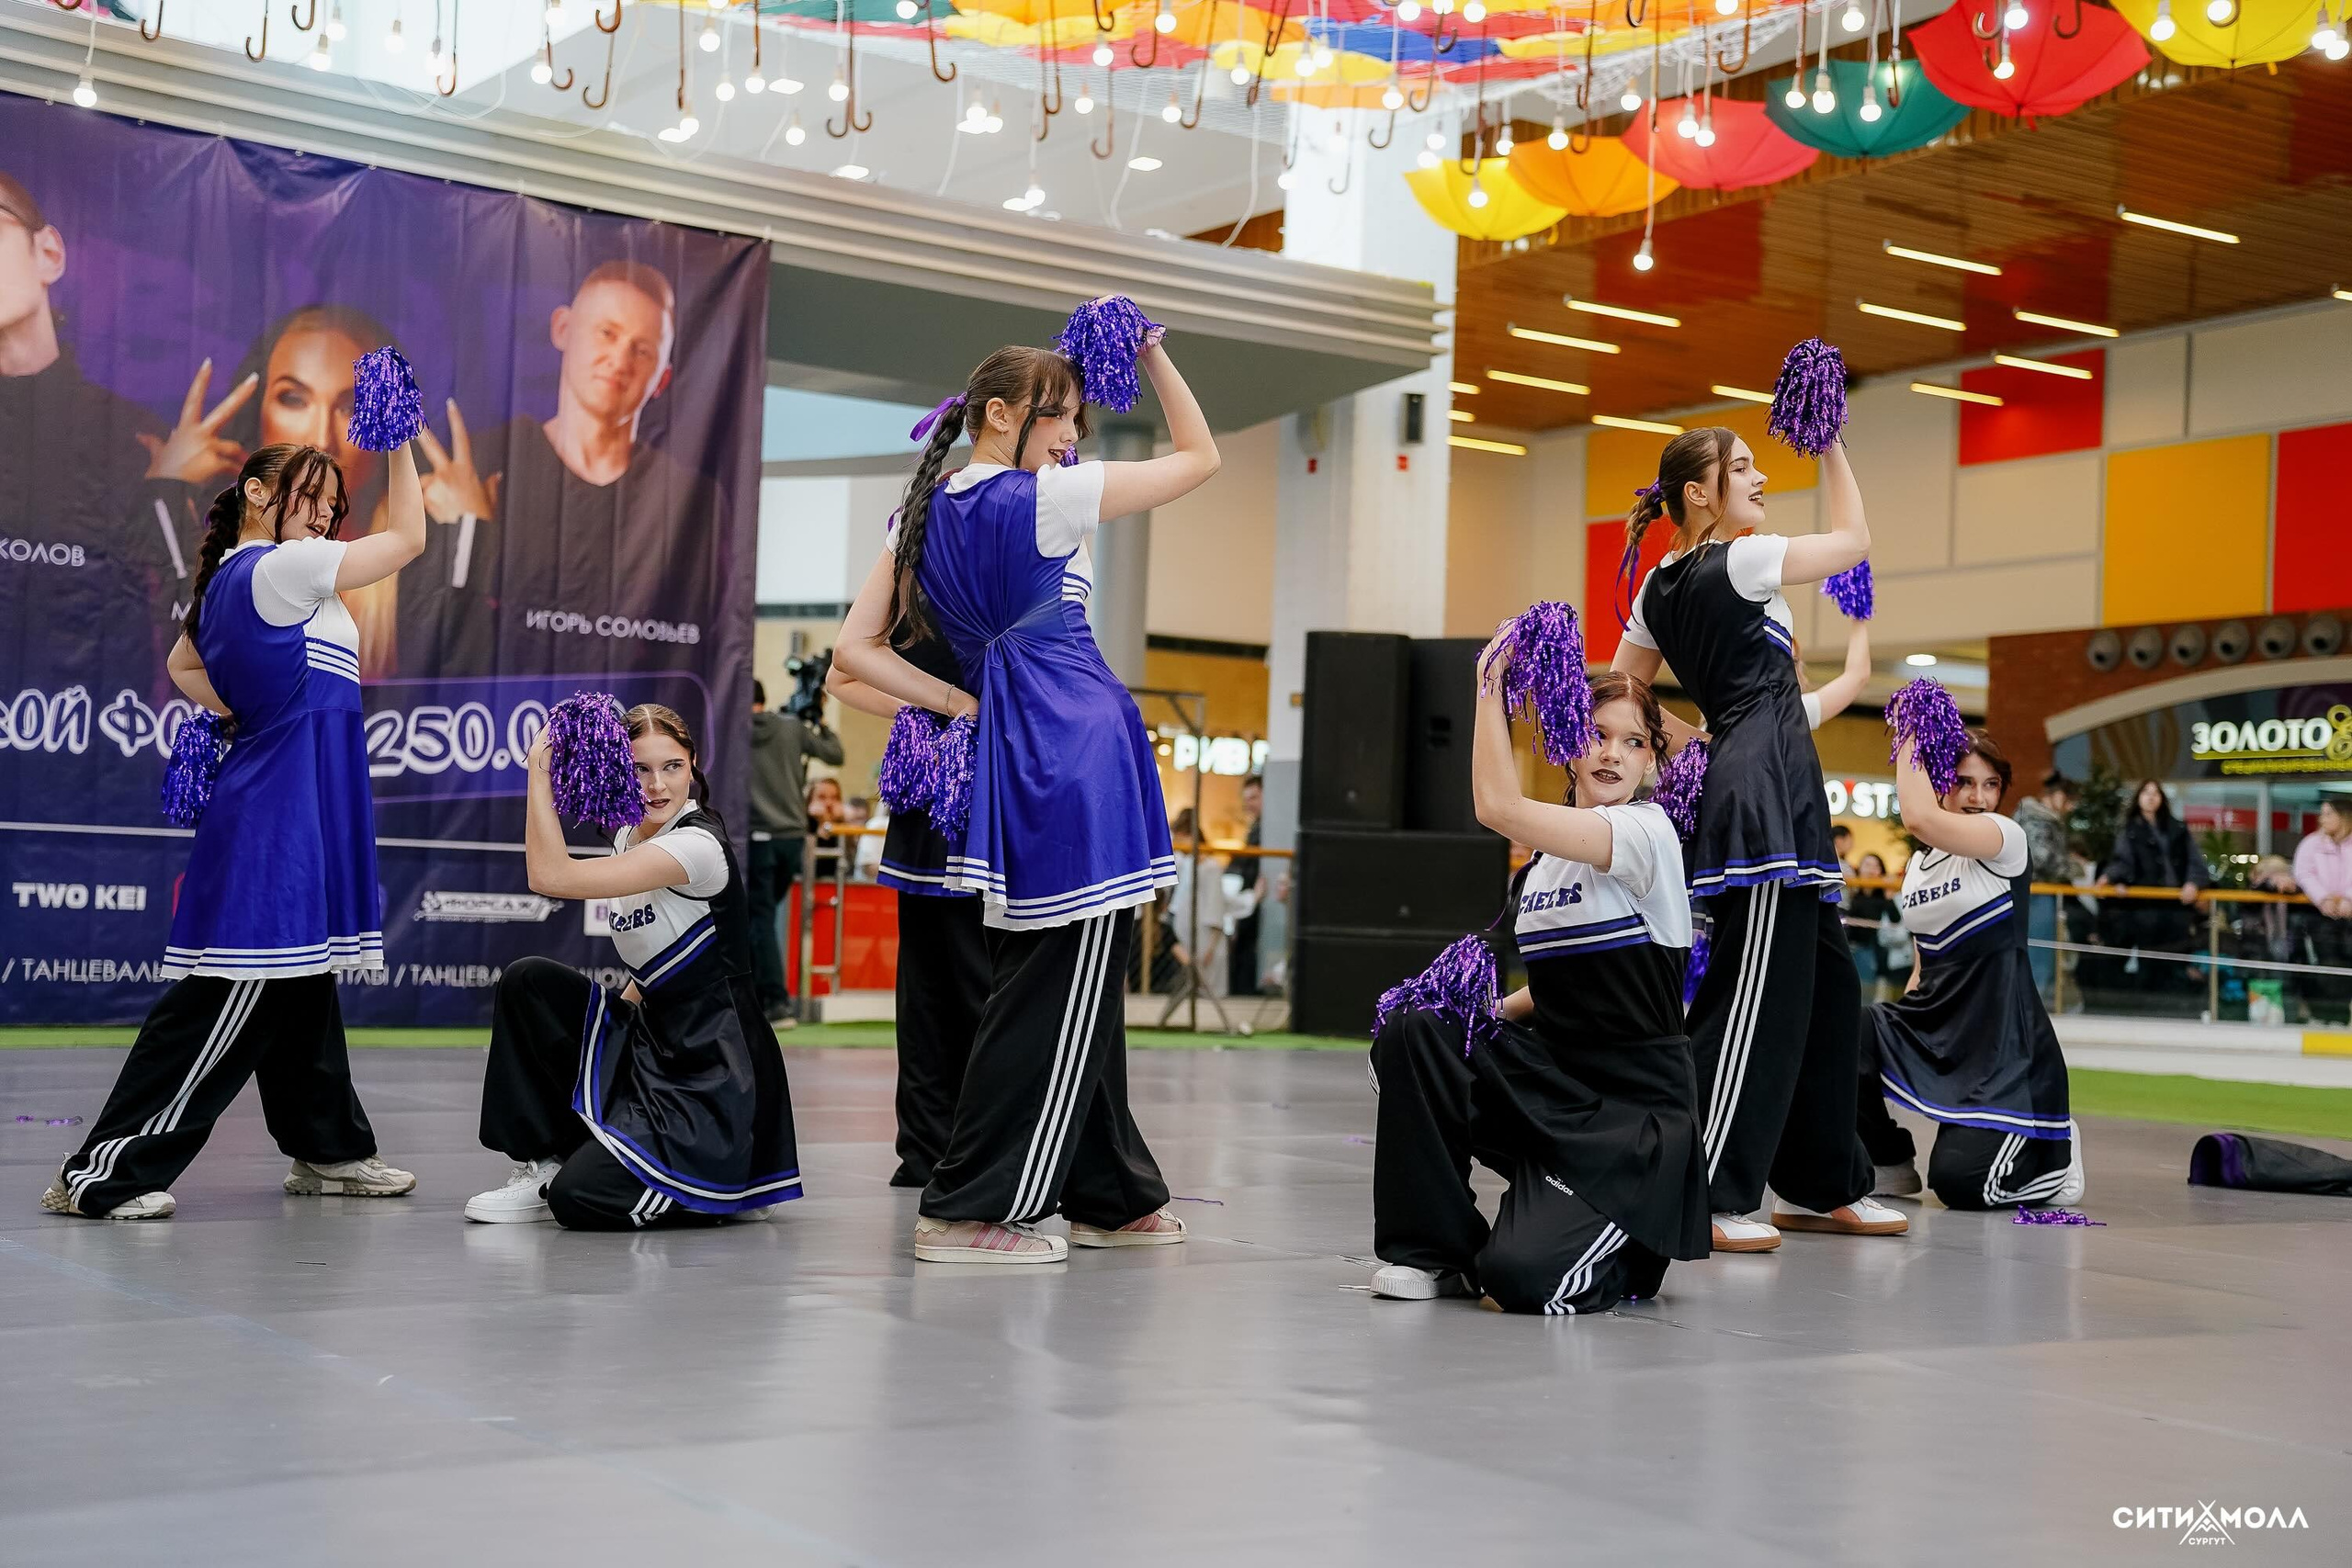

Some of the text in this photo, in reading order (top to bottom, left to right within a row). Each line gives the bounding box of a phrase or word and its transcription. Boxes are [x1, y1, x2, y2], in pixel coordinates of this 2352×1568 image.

[526, 609, 701, 644] ИГОРЬ СОЛОВЬЕВ
[2191, 717, 2333, 754] ЗОЛОТО
[12, 882, 147, 911] TWO KEI
[21, 957, 182, 985] ТАНЦЕВАЛЬ
[1545, 1175, 1574, 1196] adidas
